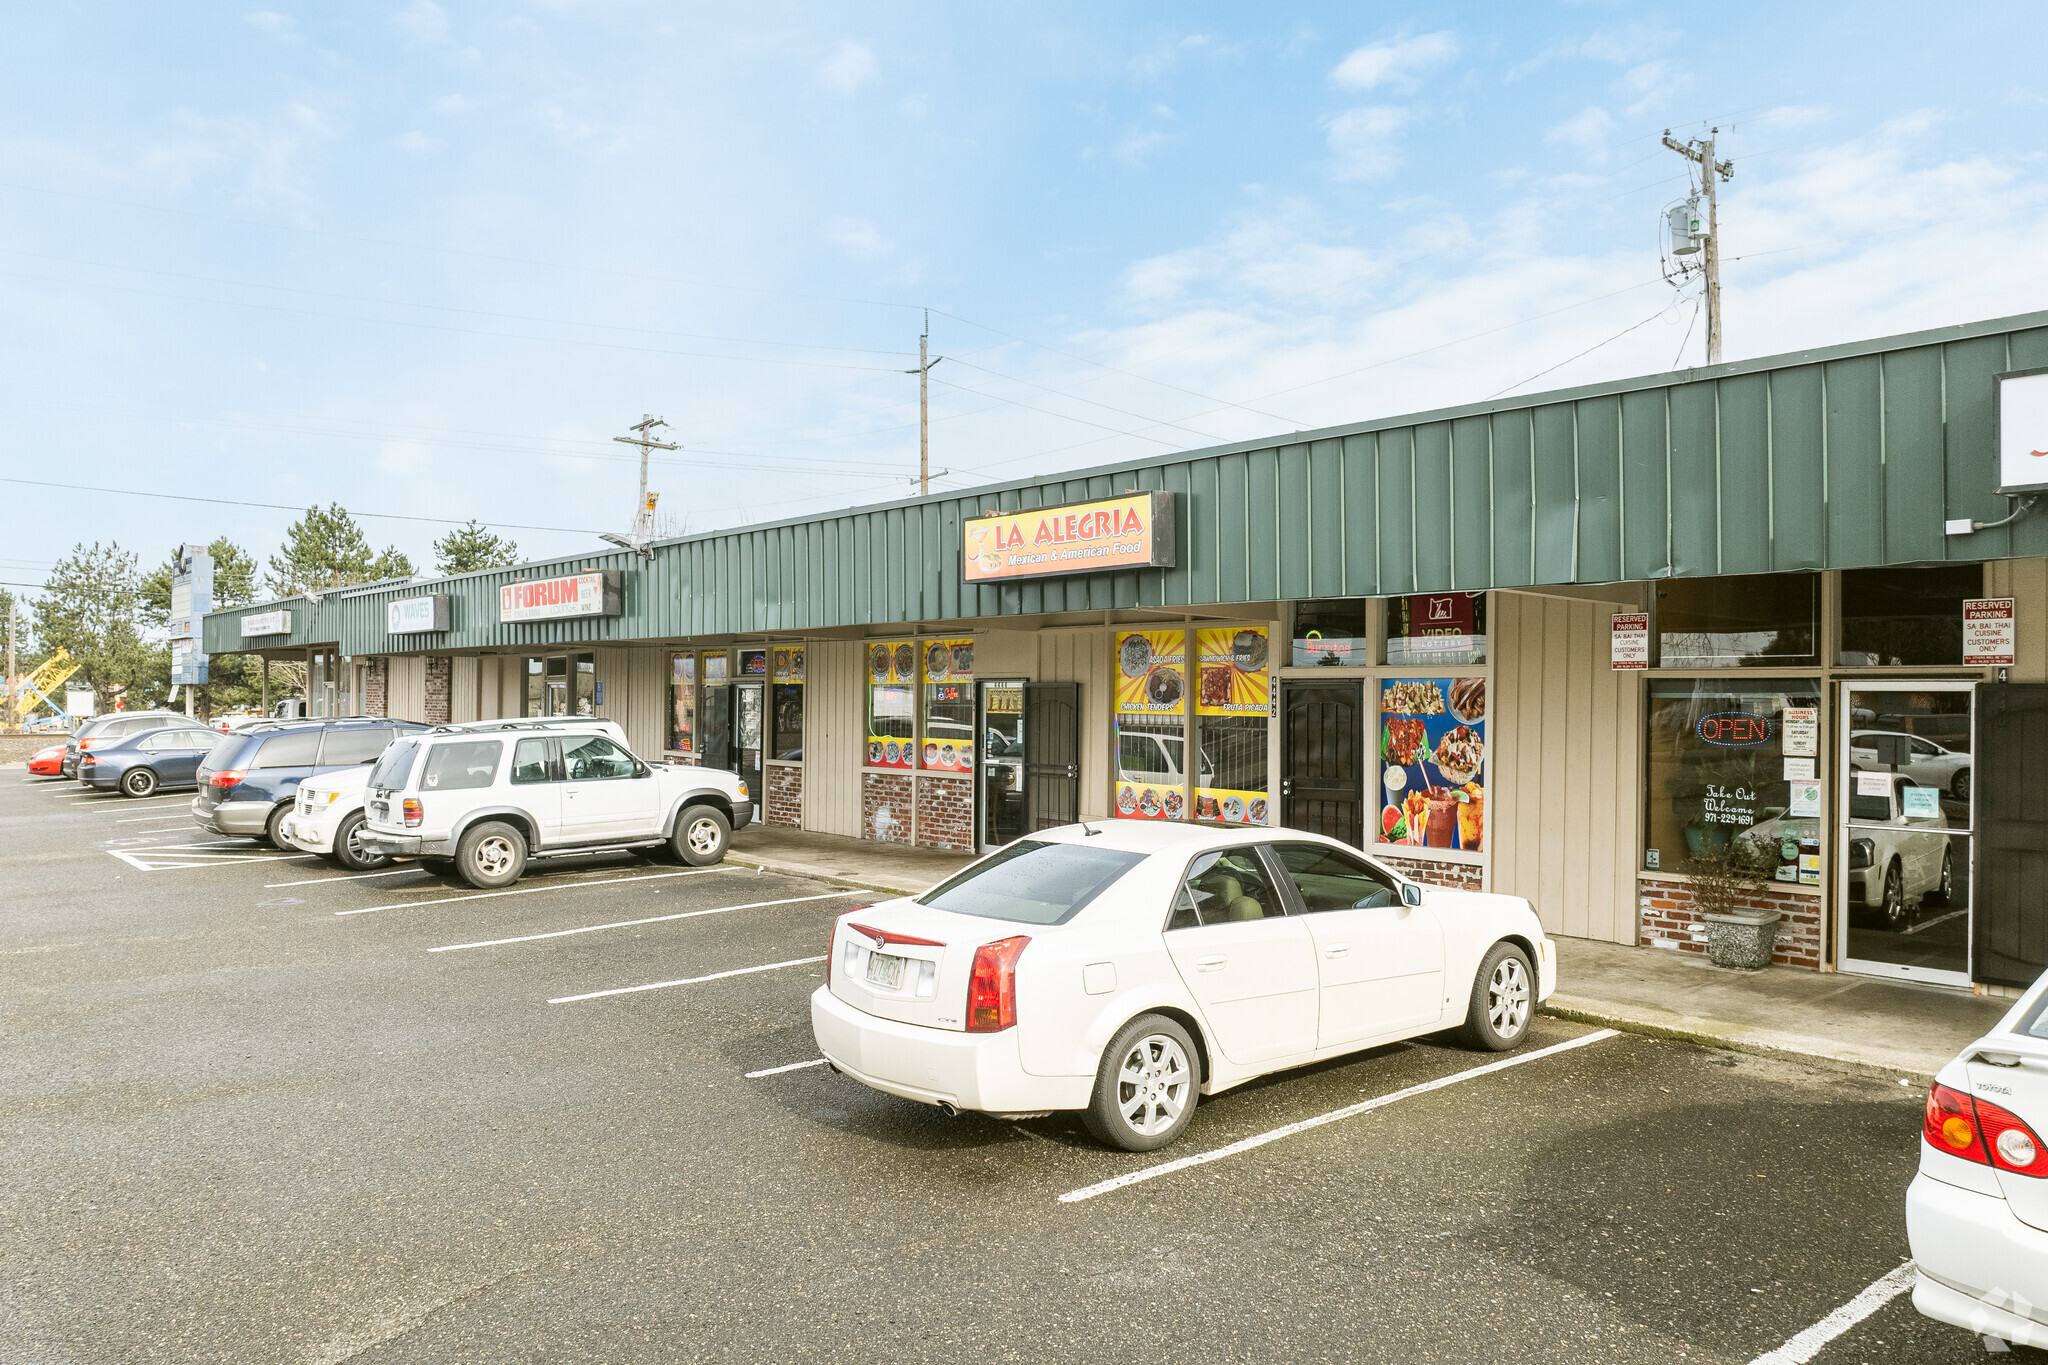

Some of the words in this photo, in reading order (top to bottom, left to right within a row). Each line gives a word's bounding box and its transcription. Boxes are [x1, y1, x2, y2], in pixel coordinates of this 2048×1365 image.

[994, 520, 1027, 551] LA
[1033, 504, 1145, 547] ALEGRIA
[1008, 552, 1048, 567] Mexican
[1050, 551, 1058, 562] &
[1060, 543, 1110, 561] American
[1112, 540, 1142, 555] Food
[578, 575, 596, 585] COCKTAIL
[514, 578, 578, 608] FORUM
[581, 589, 591, 599] BEER
[404, 602, 430, 620] WAVES
[581, 603, 591, 612] WINE
[1965, 601, 2011, 610] RESERVED
[1969, 611, 2008, 619] PARKING
[1421, 627, 1462, 641] VIDEO
[1306, 640, 1351, 655] Burritos
[1421, 639, 1462, 648] LOTTERY
[1967, 638, 2010, 646] CUSTOMERS
[1149, 654, 1168, 664] ASADA
[1169, 653, 1185, 664] FRIES
[1236, 653, 1251, 662] FRIES
[944, 687, 959, 700] Coffee
[1120, 703, 1145, 711] CHICKEN
[1146, 703, 1174, 711] TENDERS
[1244, 704, 1268, 712] PICADA
[1703, 719, 1765, 740] OPEN
[1706, 784, 1733, 798] Take
[1735, 787, 1757, 801] Out
[1704, 798, 1755, 815] Welcome
[1704, 813, 1754, 825] 971-229-1691
[1976, 1083, 2012, 1096] TOYOTA
